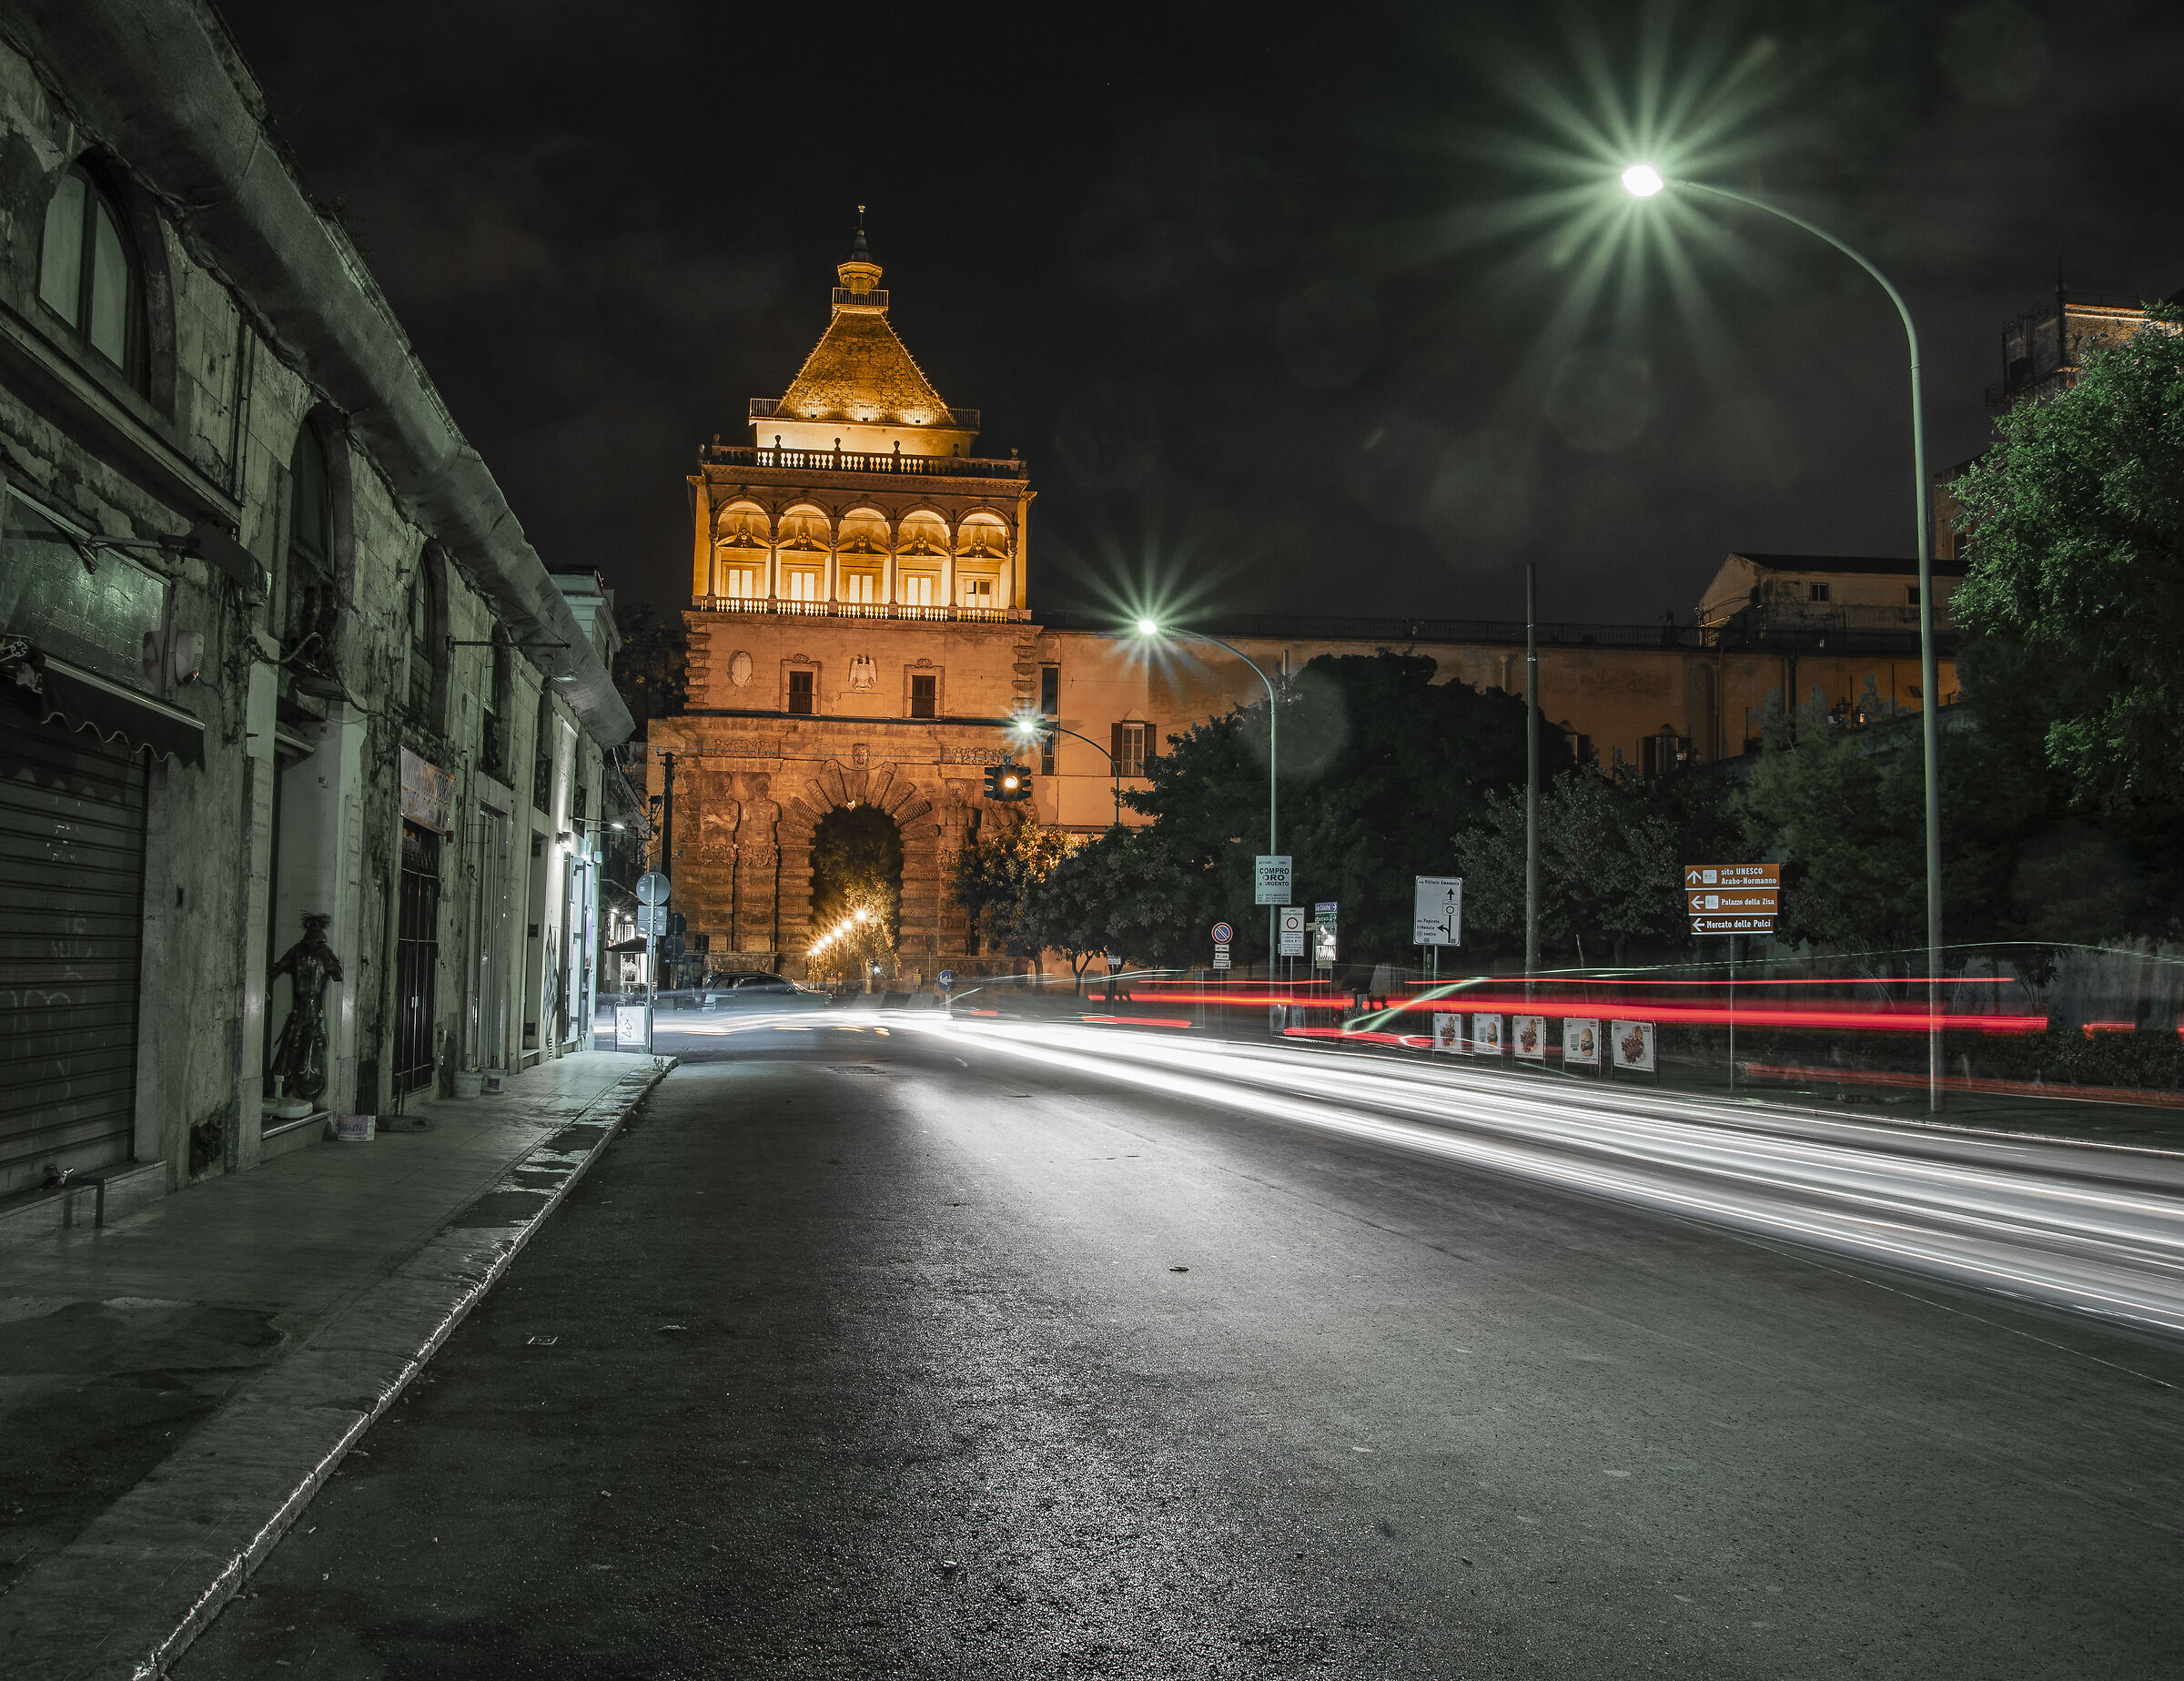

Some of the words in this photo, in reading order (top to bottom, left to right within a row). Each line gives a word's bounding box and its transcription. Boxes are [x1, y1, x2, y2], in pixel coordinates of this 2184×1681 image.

[1721, 876, 1777, 885] Arabo-Normanno
[1762, 897, 1774, 906] Zisa
[1706, 920, 1733, 928] Mercato
[1734, 920, 1752, 928] delle
[1753, 919, 1771, 927] Pulci
